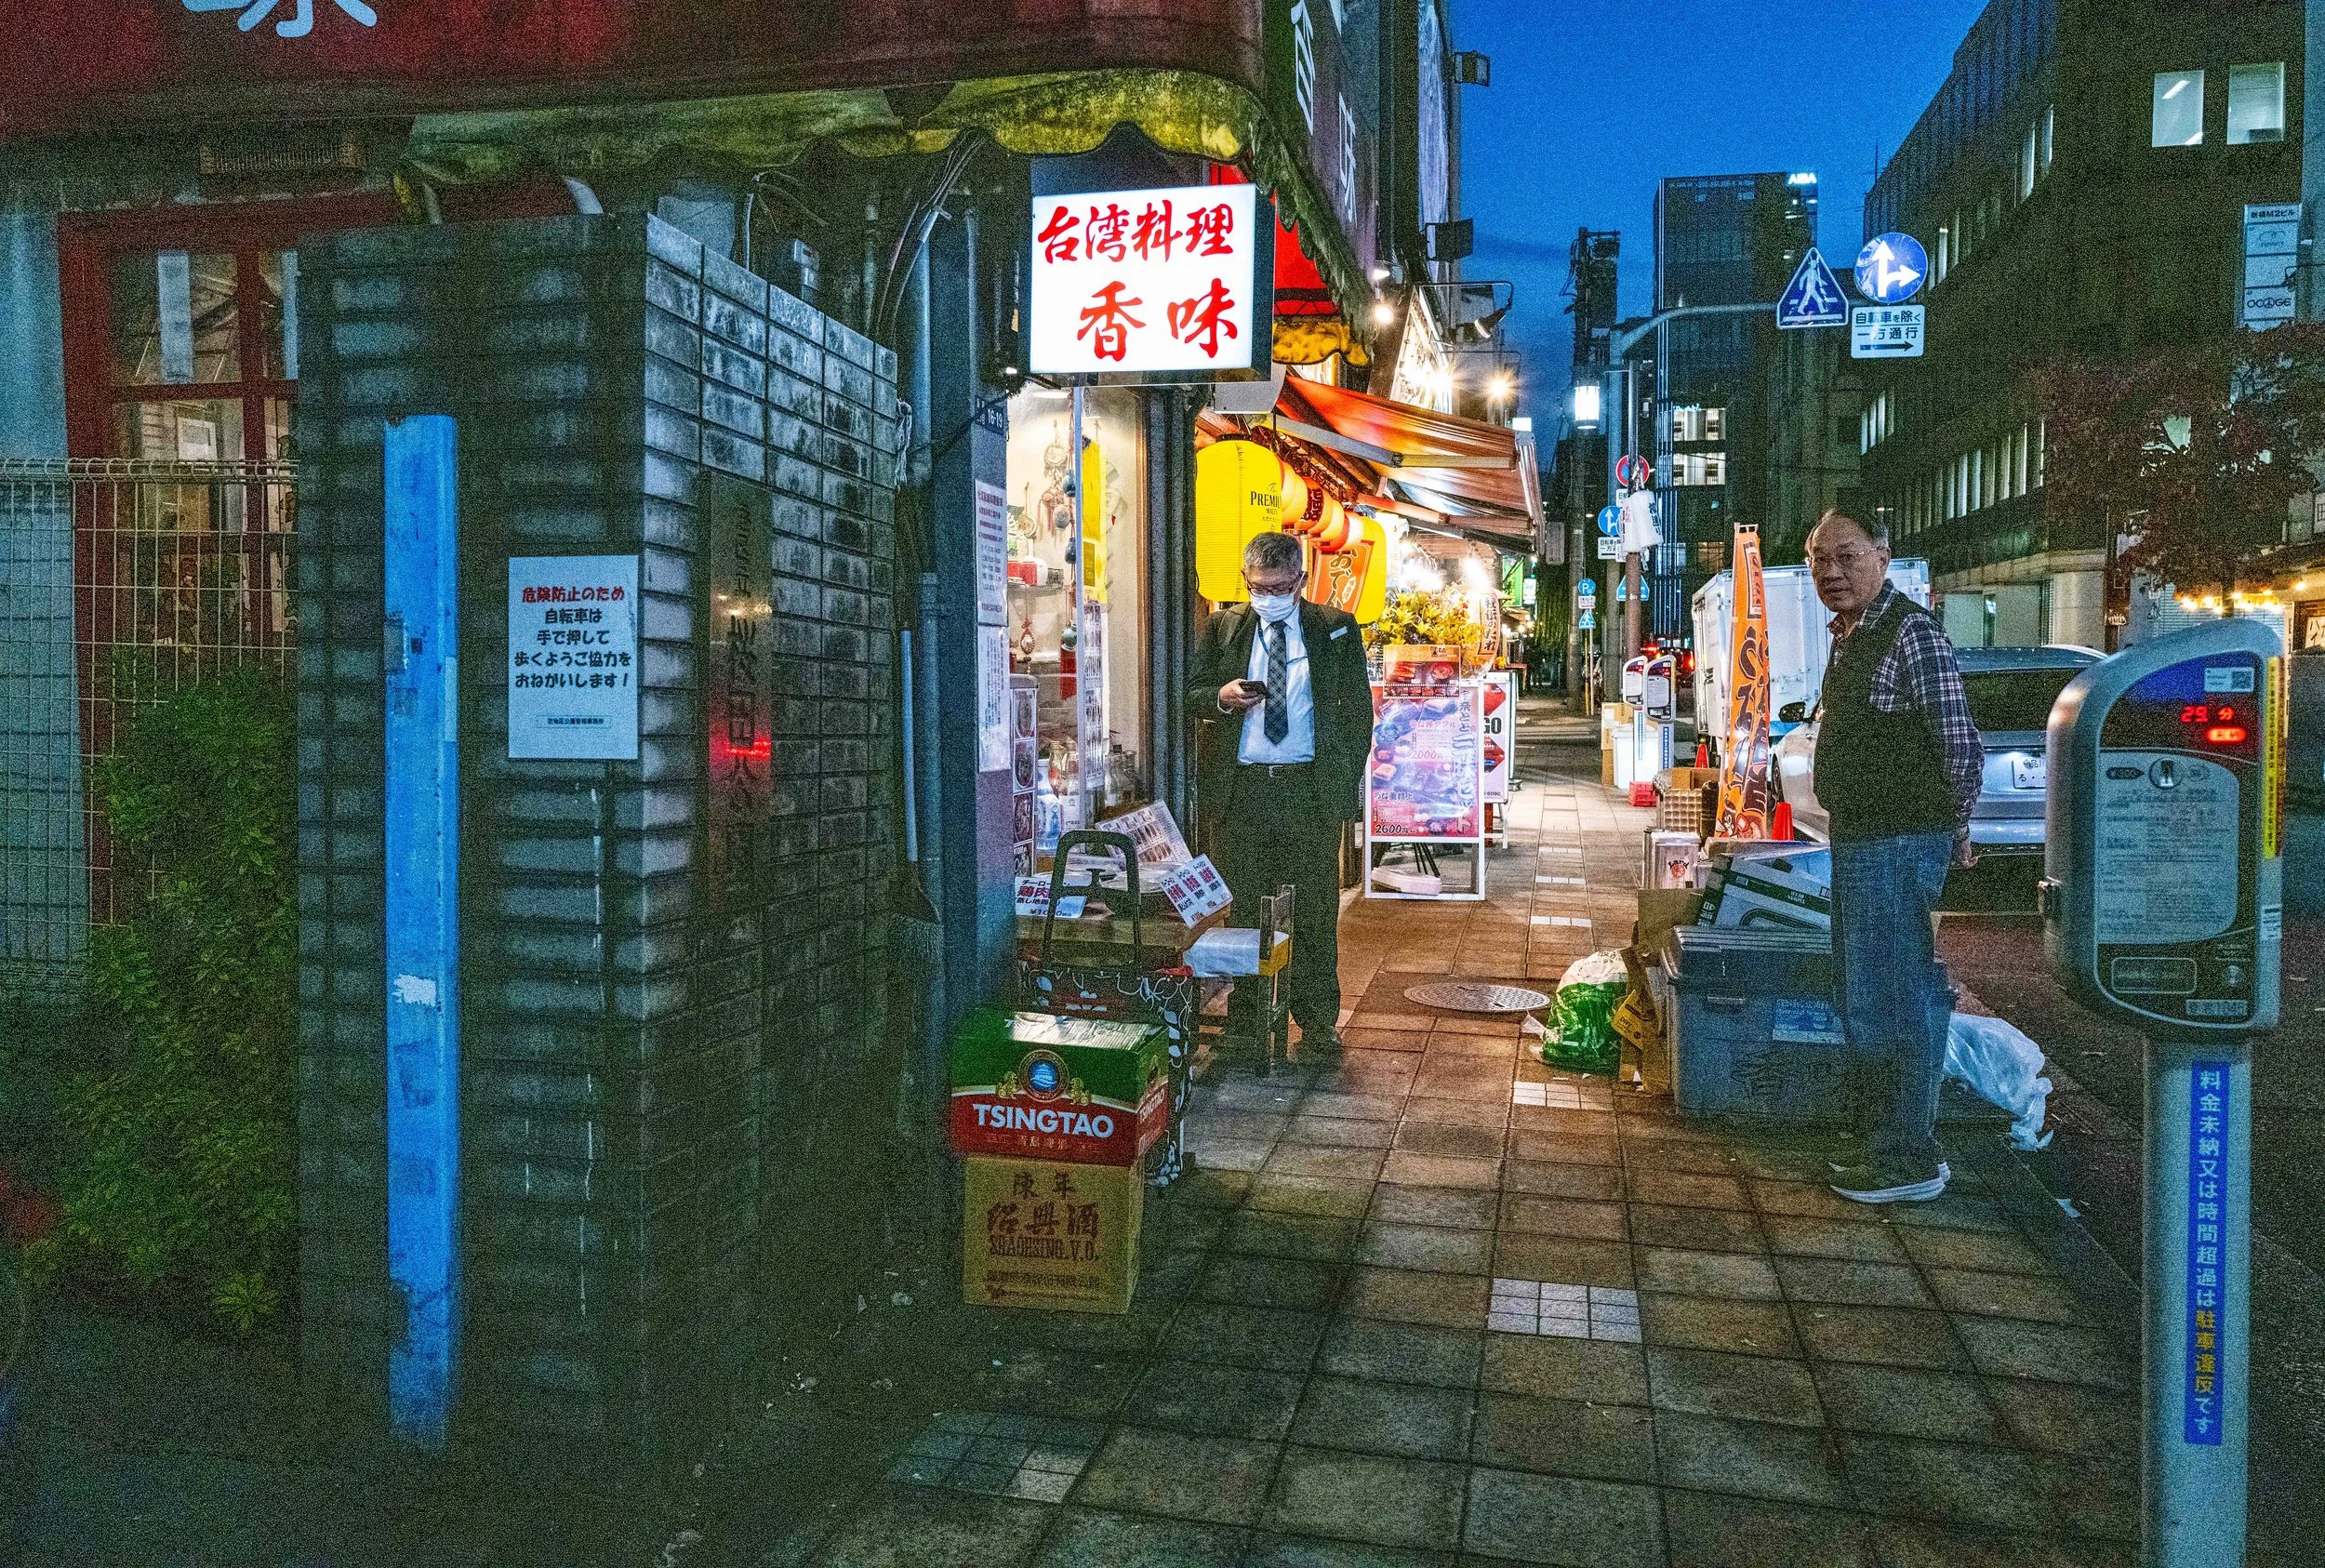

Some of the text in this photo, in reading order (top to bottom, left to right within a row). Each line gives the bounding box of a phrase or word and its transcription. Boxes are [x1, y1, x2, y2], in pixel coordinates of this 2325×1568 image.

[1038, 199, 1234, 263] 台湾料理
[1077, 277, 1239, 363] 香味
[1855, 310, 1921, 326] 自転車を除く
[1856, 326, 1919, 341] 一方通行
[522, 586, 625, 604] 危険防止のため
[545, 608, 603, 625] 自転車は
[537, 630, 610, 646] 手で押して
[514, 651, 631, 668] 歩くようご協力を
[514, 672, 630, 689] おねがいします！
[1375, 824, 1409, 835] 2600円
[1667, 859, 1690, 870] Lard
[973, 1103, 1114, 1139] TSINGTAO
